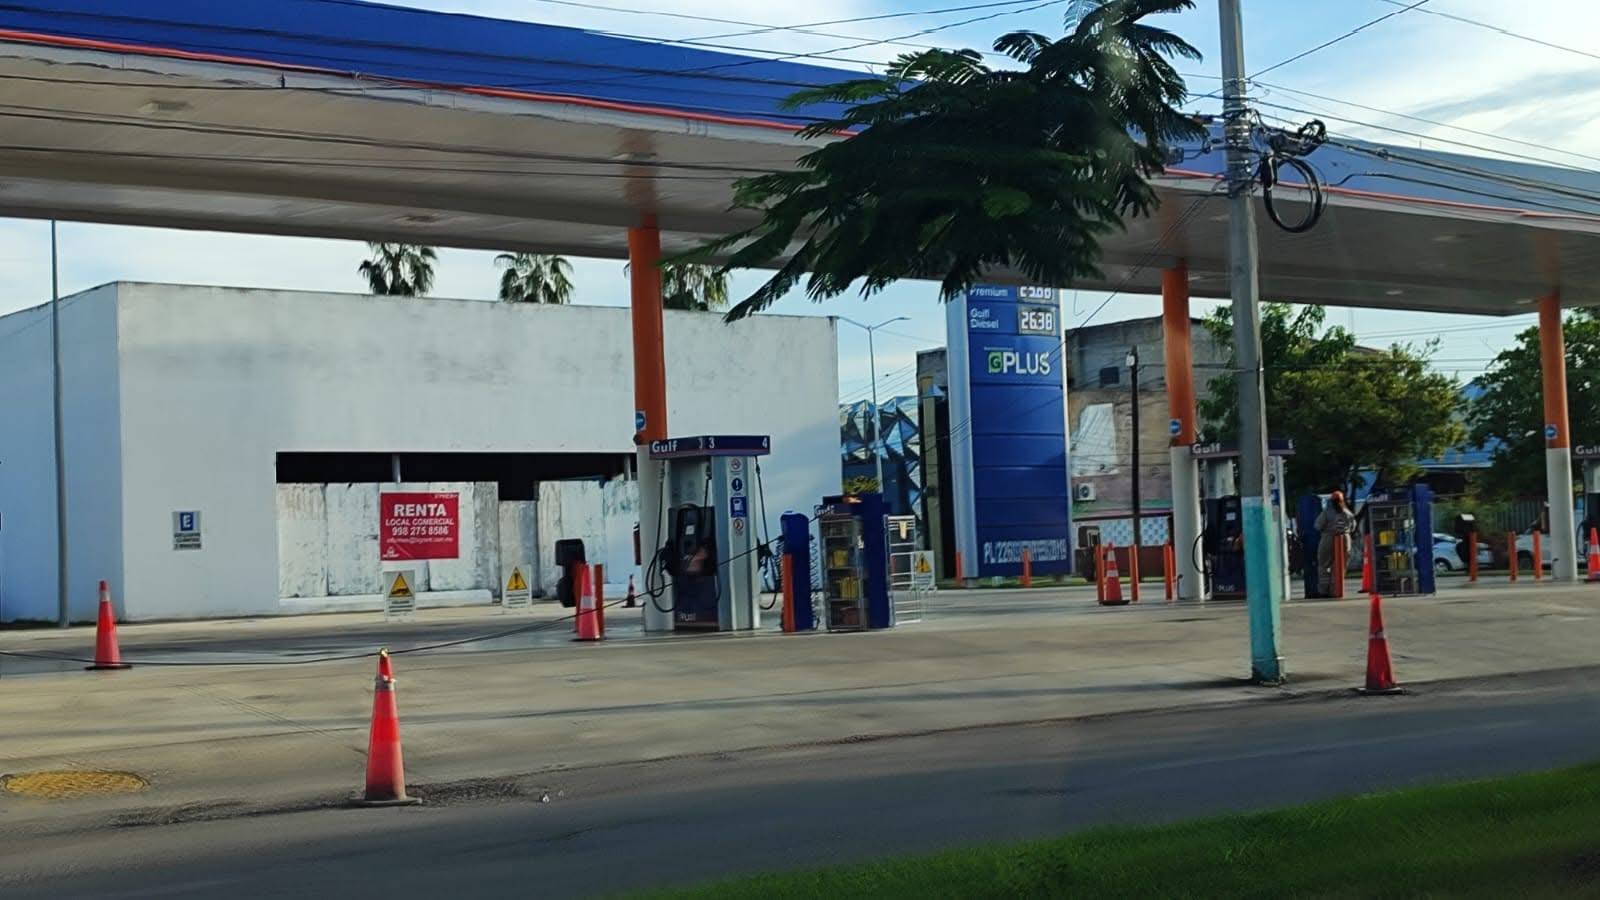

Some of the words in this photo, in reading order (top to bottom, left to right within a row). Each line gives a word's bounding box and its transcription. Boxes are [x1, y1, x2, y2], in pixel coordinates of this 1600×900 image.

[970, 319, 999, 329] Diesel
[651, 439, 678, 453] Gulf
[1192, 443, 1221, 454] Gulf
[393, 503, 447, 517] RENTA
[182, 514, 191, 529] E
[385, 518, 411, 526] LOCAL
[412, 518, 455, 526] COMERCIAL
[392, 526, 409, 536] 998
[410, 526, 427, 536] 275
